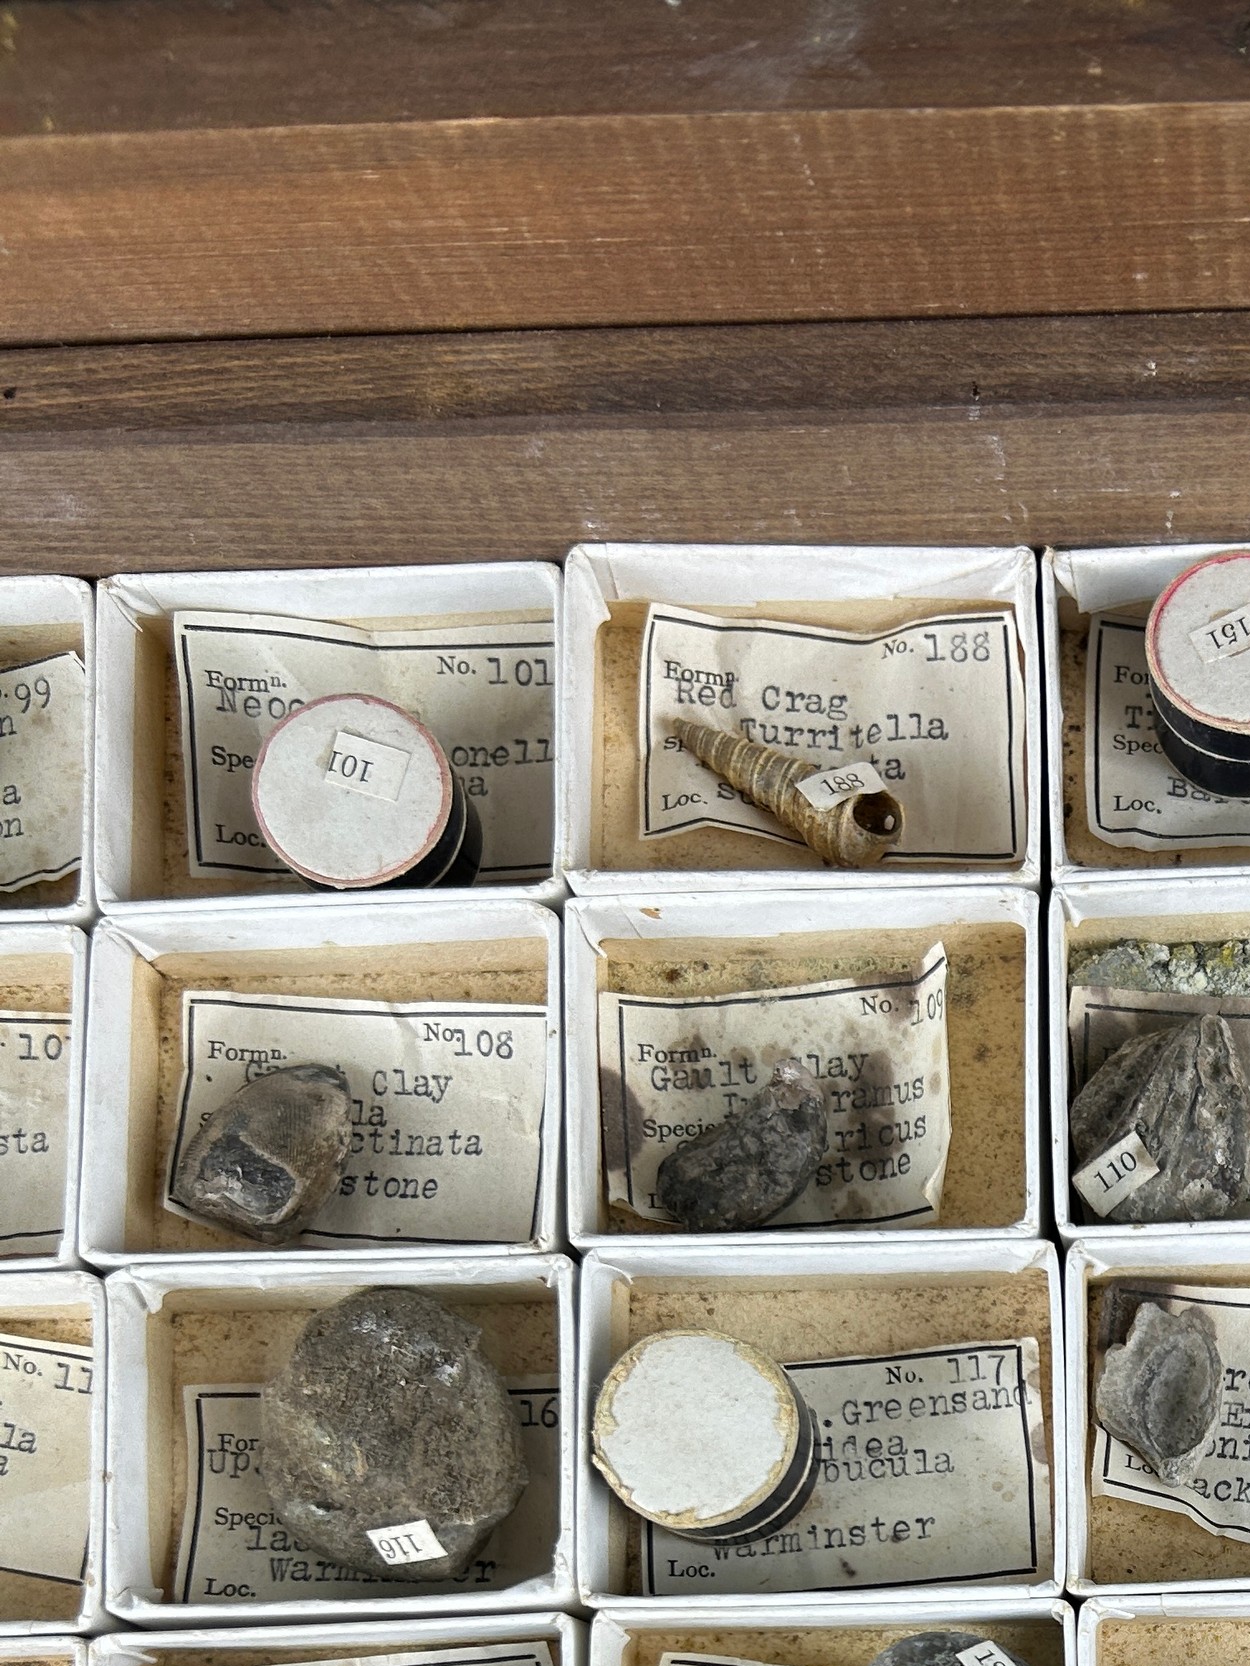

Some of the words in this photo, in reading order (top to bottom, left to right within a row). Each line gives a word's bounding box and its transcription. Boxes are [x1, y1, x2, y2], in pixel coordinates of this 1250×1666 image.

[1206, 615, 1249, 649] 151
[881, 639, 914, 660] No.
[923, 632, 990, 662] 188
[437, 656, 477, 676] No.
[676, 681, 736, 710] Red
[761, 685, 848, 720] Crag
[740, 714, 949, 751] Turritella
[329, 751, 374, 783] 101
[824, 772, 866, 798] 188
[661, 790, 708, 811] Loc.
[1113, 795, 1162, 816] Loc.
[860, 997, 899, 1017] No.
[453, 1029, 514, 1060] 108
[651, 1061, 758, 1092] Gault
[806, 1052, 869, 1082] lay
[372, 1070, 452, 1104] Clay
[350, 1131, 483, 1158] ctinata
[1093, 1151, 1138, 1193] 110
[886, 1367, 924, 1384] No.
[946, 1355, 1006, 1384] 117
[380, 1535, 423, 1560] 116
[668, 1560, 715, 1579] Loc.
[204, 1577, 257, 1599] Loc.
